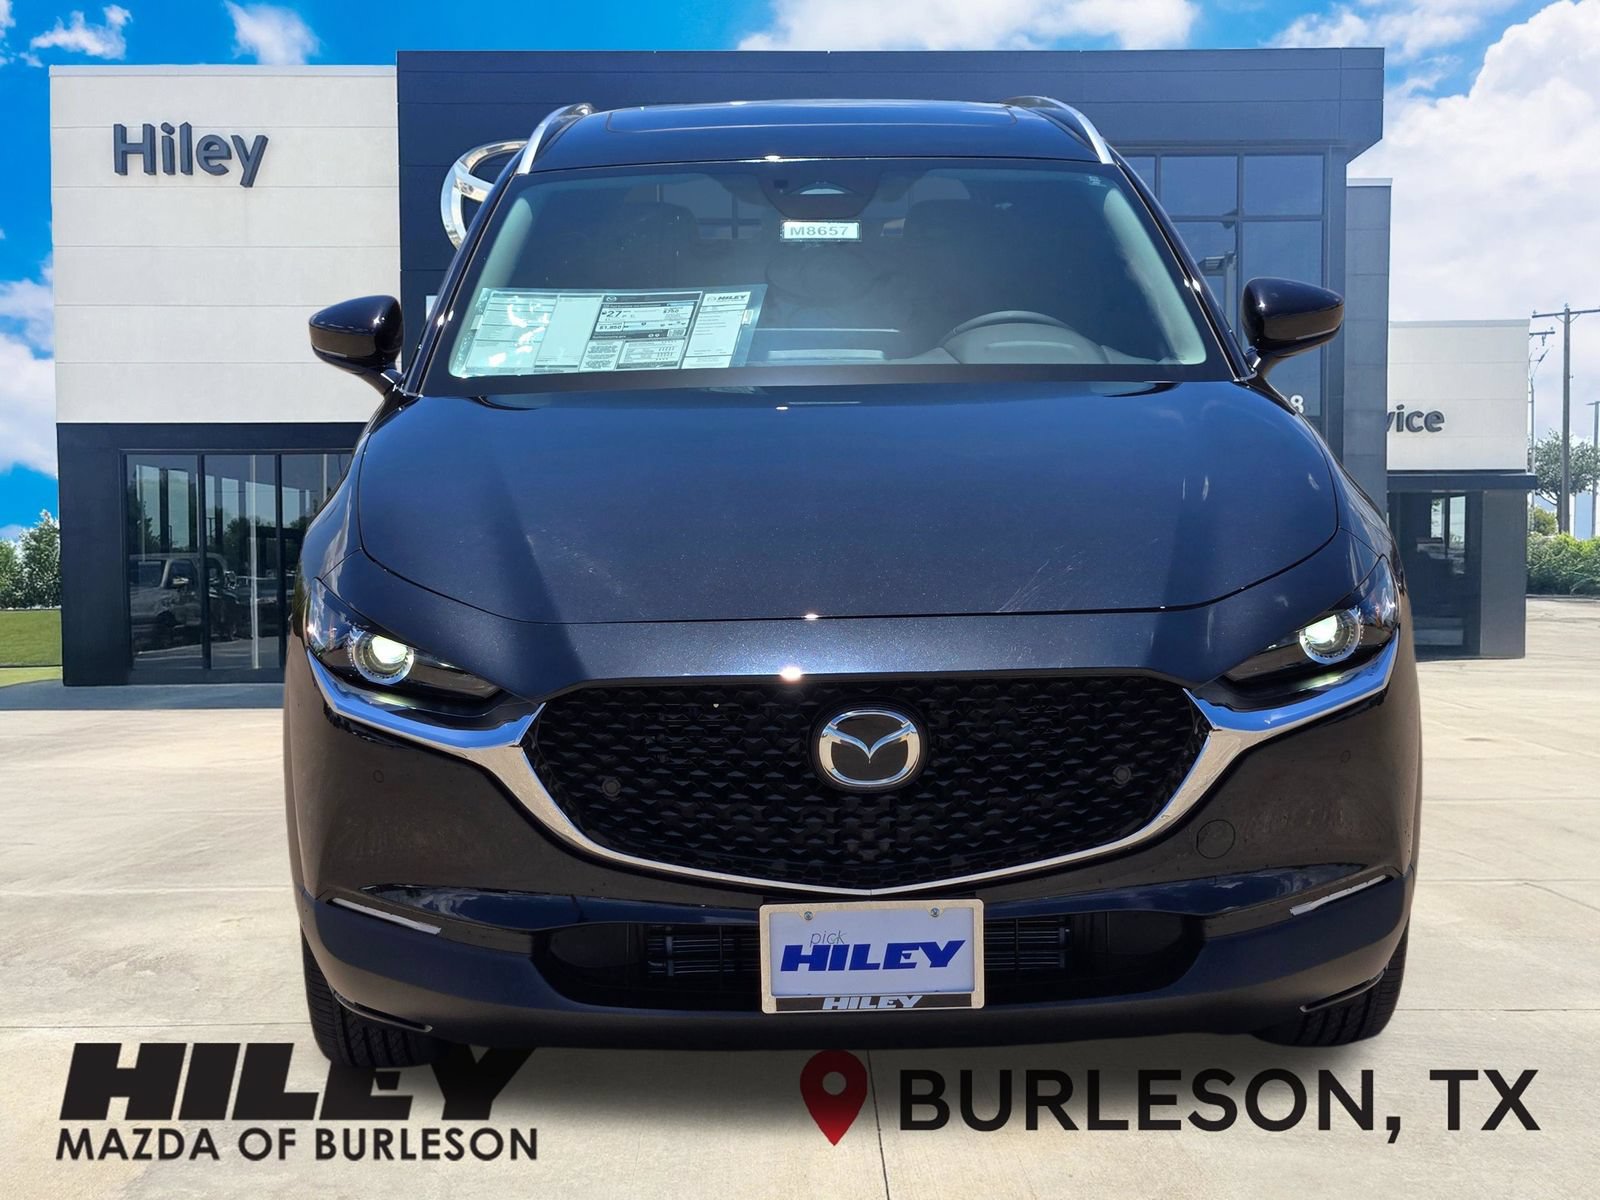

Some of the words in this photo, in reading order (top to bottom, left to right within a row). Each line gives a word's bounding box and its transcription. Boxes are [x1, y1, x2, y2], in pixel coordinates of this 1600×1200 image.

[113, 121, 269, 188] Hiley
[790, 226, 849, 236] M8657
[809, 930, 847, 947] pick
[780, 940, 966, 972] HILEY
[822, 995, 923, 1010] HILEY
